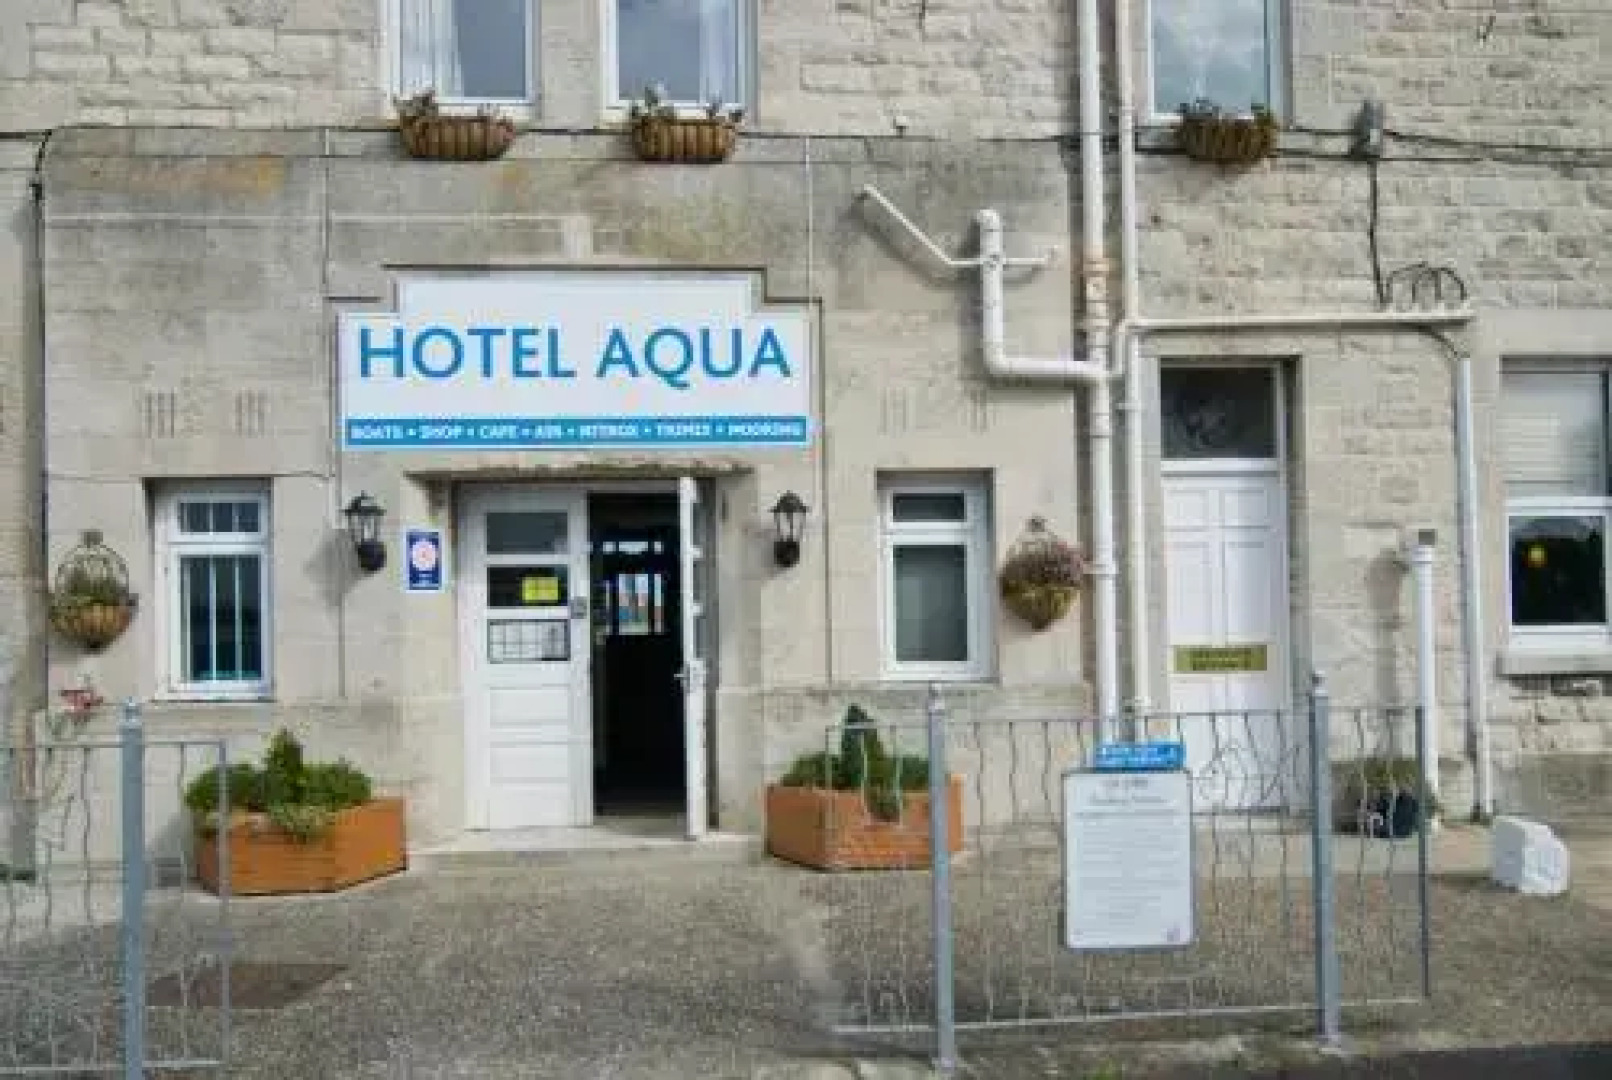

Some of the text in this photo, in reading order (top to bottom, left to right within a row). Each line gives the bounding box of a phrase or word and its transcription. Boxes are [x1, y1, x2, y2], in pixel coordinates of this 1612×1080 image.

[359, 327, 792, 390] HOTEL AQUA
[419, 424, 463, 439] SHOP
